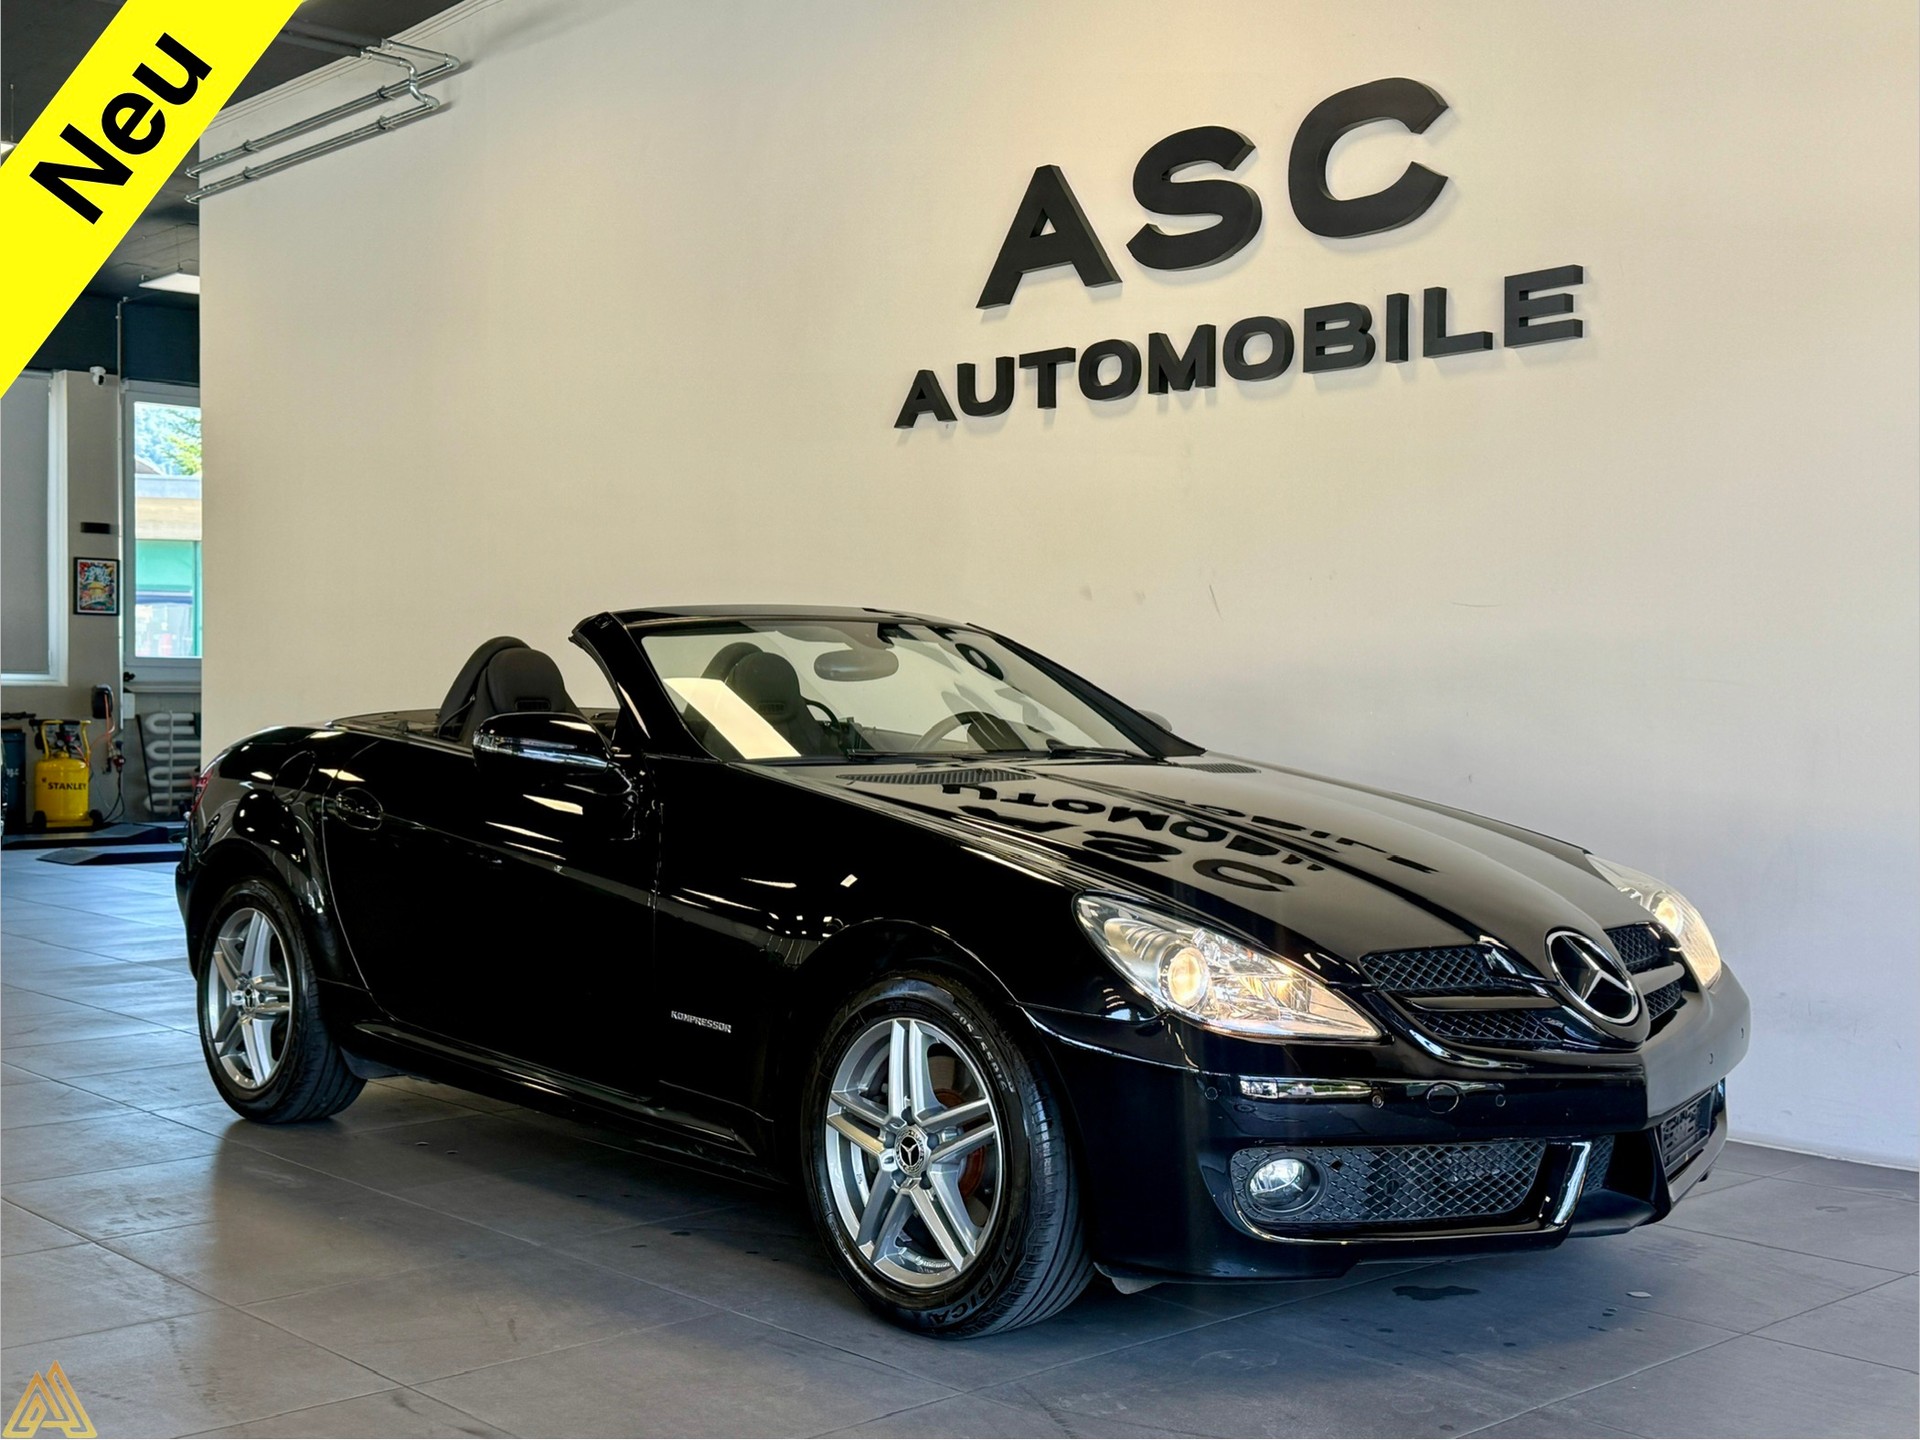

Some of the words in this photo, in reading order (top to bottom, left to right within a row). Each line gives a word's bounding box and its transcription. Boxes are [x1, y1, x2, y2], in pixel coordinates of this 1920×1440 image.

[975, 77, 1449, 310] ASC
[894, 265, 1584, 429] AUTOMOBILE
[47, 782, 87, 791] STANLEY
[670, 1010, 732, 1034] KOMPRESSOR
